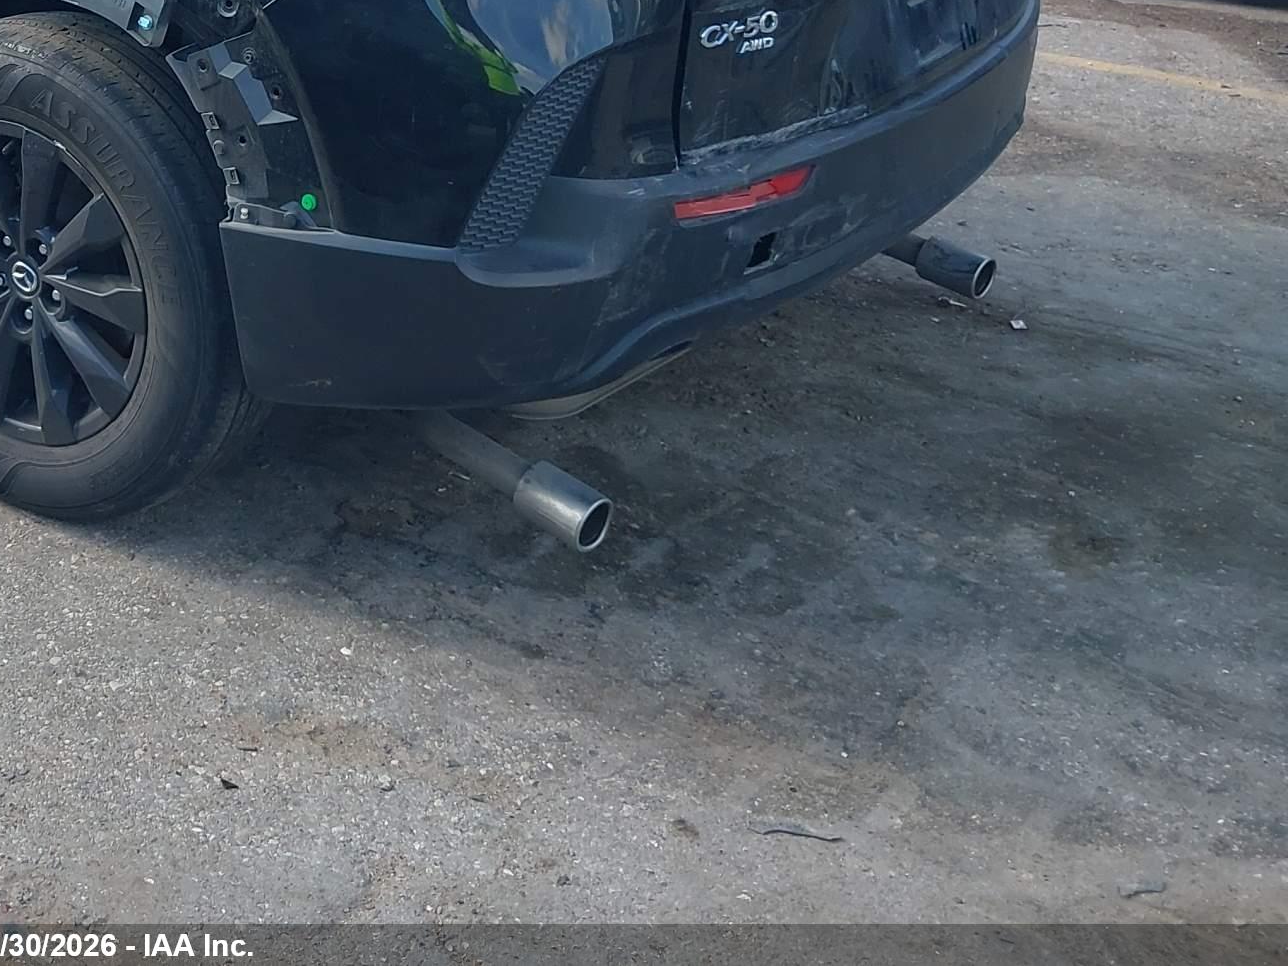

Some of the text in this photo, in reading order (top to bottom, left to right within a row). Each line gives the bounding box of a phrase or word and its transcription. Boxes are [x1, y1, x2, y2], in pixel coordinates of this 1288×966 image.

[700, 10, 779, 49] CX-50
[739, 37, 774, 54] AWD
[30, 88, 182, 308] ASSURANCE
